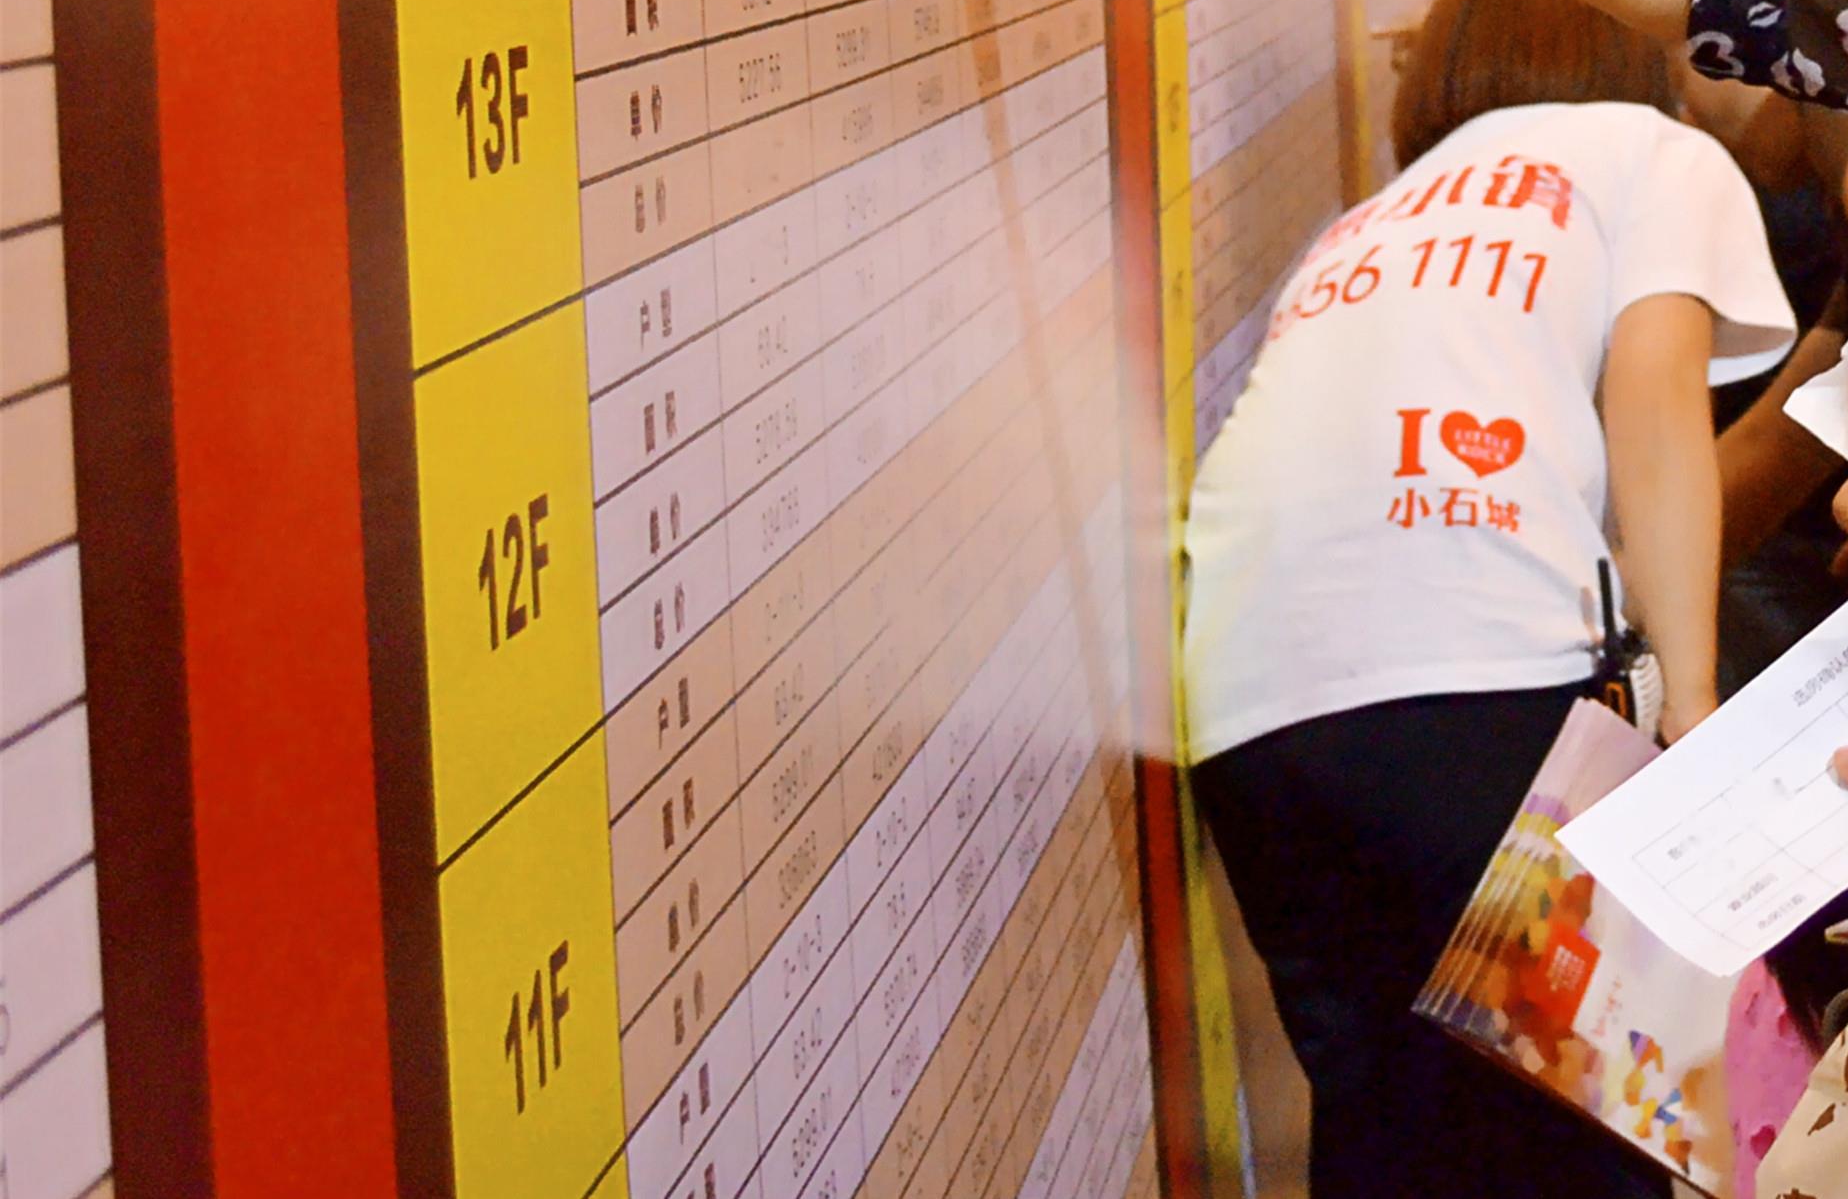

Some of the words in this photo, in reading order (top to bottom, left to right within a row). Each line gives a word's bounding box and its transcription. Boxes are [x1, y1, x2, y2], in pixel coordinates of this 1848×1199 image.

[455, 44, 530, 180] 13F
[1411, 233, 1548, 314] 1111
[1393, 407, 1431, 478] I
[1387, 487, 1521, 532] 小石城
[477, 493, 550, 652] 12F
[503, 939, 570, 1116] 11F
